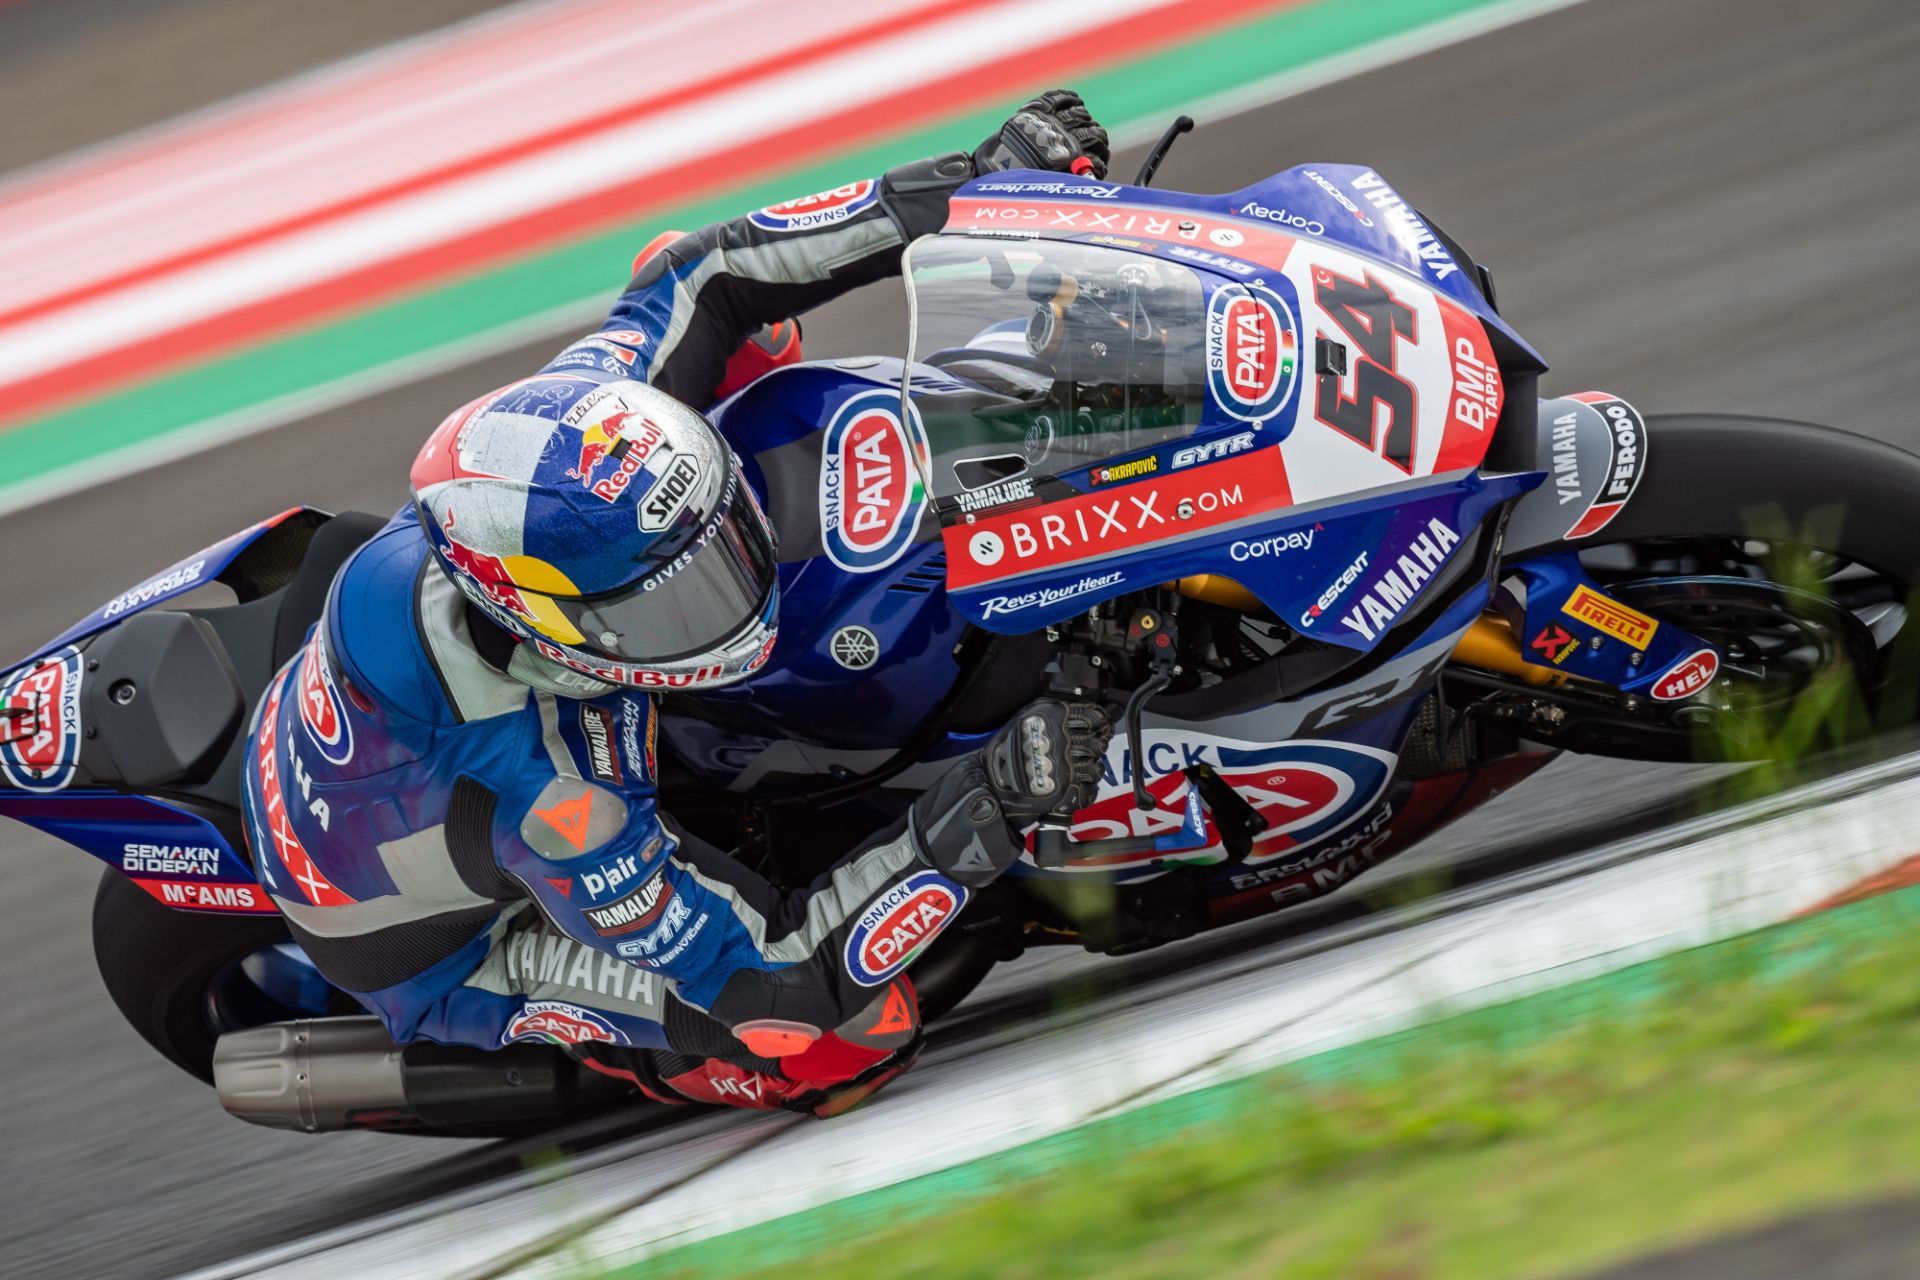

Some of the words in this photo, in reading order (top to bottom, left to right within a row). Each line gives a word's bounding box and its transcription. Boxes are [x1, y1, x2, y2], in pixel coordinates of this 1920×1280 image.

[791, 208, 847, 227] SNACK
[1062, 185, 1122, 199] Revs
[1240, 202, 1325, 237] Corpay
[1350, 171, 1458, 281] YAMAHA
[1211, 314, 1225, 369] SNACK
[1235, 312, 1266, 390] PATA
[1309, 263, 1420, 476] 54
[1455, 336, 1487, 432] BMP
[1482, 366, 1499, 421] TAPPI
[591, 453, 641, 504] Red
[629, 418, 663, 461] Bull
[1171, 431, 1257, 471] GYTR
[1552, 411, 1582, 506] YAMAHA
[1607, 405, 1637, 497] FERODO
[646, 459, 697, 524] SHOEI
[825, 457, 840, 528] SNACK
[853, 428, 892, 533] PATA
[953, 477, 1035, 513] YAMALUBE
[642, 551, 694, 591] GIVES
[696, 511, 724, 548] YOU
[1230, 529, 1313, 563] Corpay
[979, 592, 1038, 620] Revs
[1038, 584, 1079, 608] Your
[1078, 571, 1123, 593] Heart
[1301, 550, 1369, 628] CRESCENT
[1341, 517, 1460, 643] YAMAHA
[1568, 591, 1652, 645] PIRELLI
[537, 639, 624, 683] Red
[633, 663, 723, 689] Bull
[1665, 664, 1714, 697] HEL
[65, 674, 77, 731] SNACK
[584, 705, 614, 777] YAMALUBE
[1097, 742, 1215, 788] NACK
[261, 716, 330, 905] BRIXX
[123, 843, 220, 862] SEMAKIN
[146, 859, 220, 876] DEPAN
[161, 883, 256, 908] McAMS
[589, 870, 665, 929] YAMALUBE
[864, 886, 907, 929] SNACK
[616, 893, 692, 957] GYTR
[870, 900, 945, 966] PATA
[522, 1017, 594, 1042] PATA
[526, 1004, 583, 1020] SNACK
